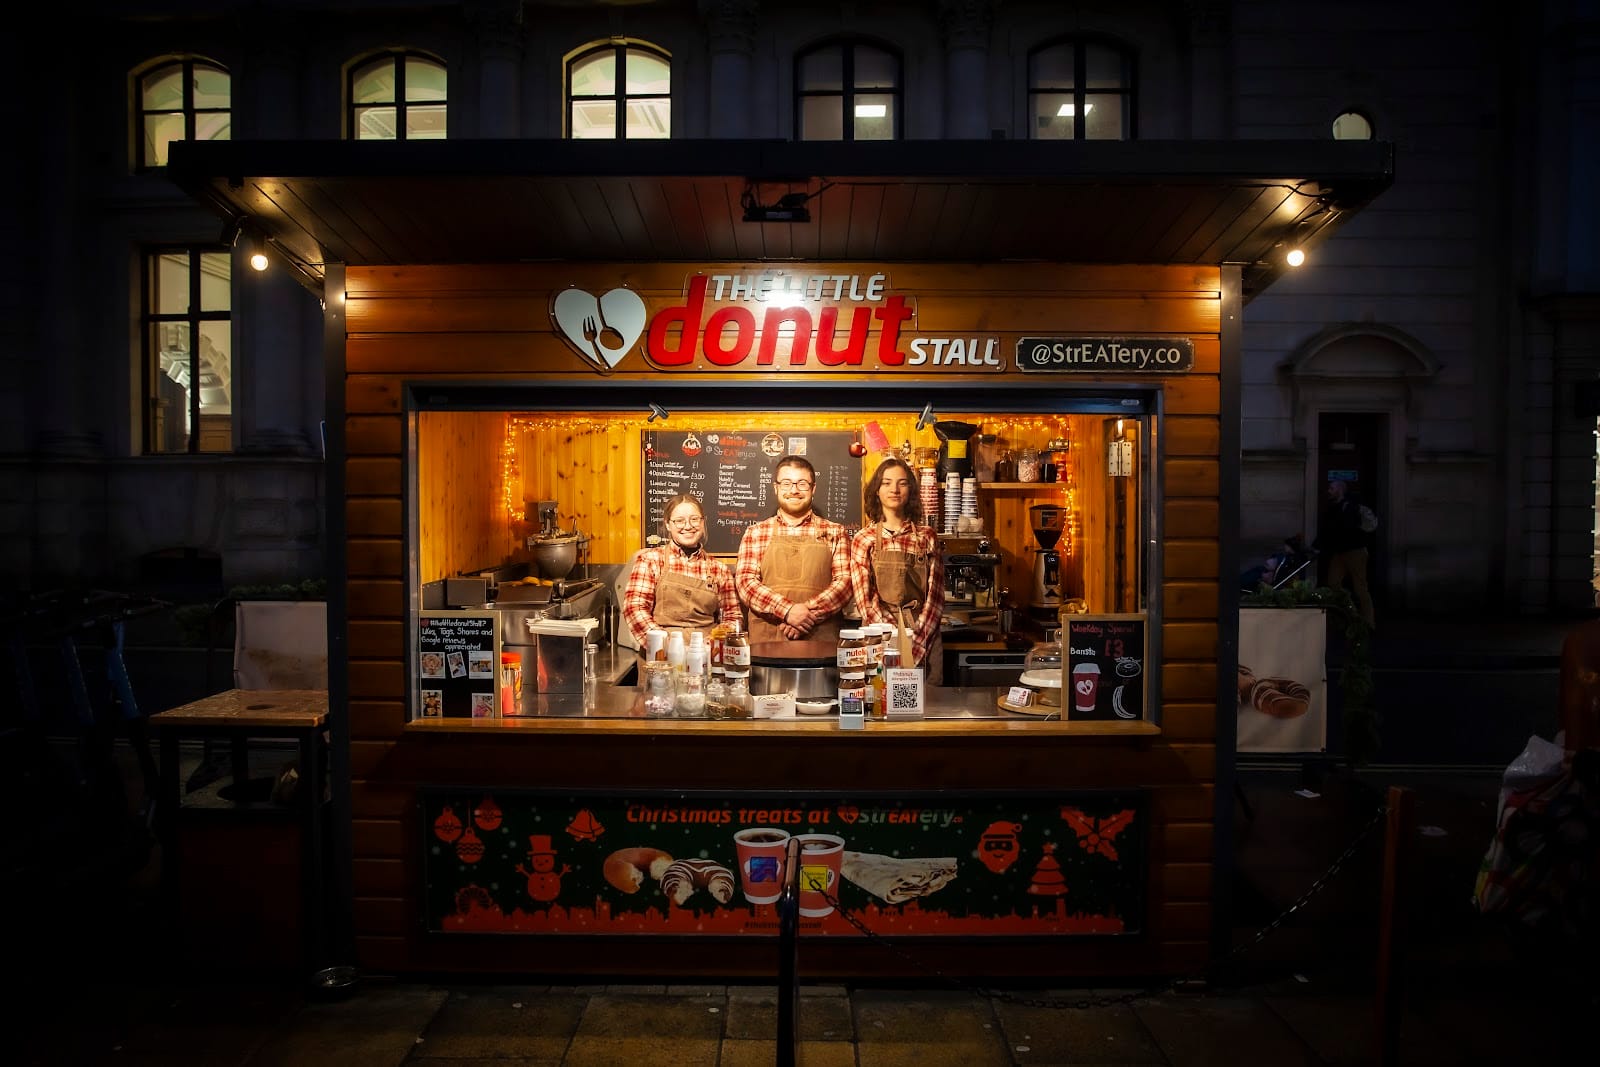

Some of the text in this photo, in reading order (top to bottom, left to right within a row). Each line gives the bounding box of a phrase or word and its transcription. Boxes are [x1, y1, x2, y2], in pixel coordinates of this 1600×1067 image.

[711, 274, 886, 301] THE LITTLE
[647, 275, 914, 366] donut
[908, 338, 999, 366] STALL
[1031, 343, 1181, 368] @StrEATery.co
[457, 627, 480, 636] Shares
[480, 628, 493, 636] and
[626, 803, 733, 824] Christmas
[738, 807, 804, 824] treats
[807, 807, 832, 824] at
